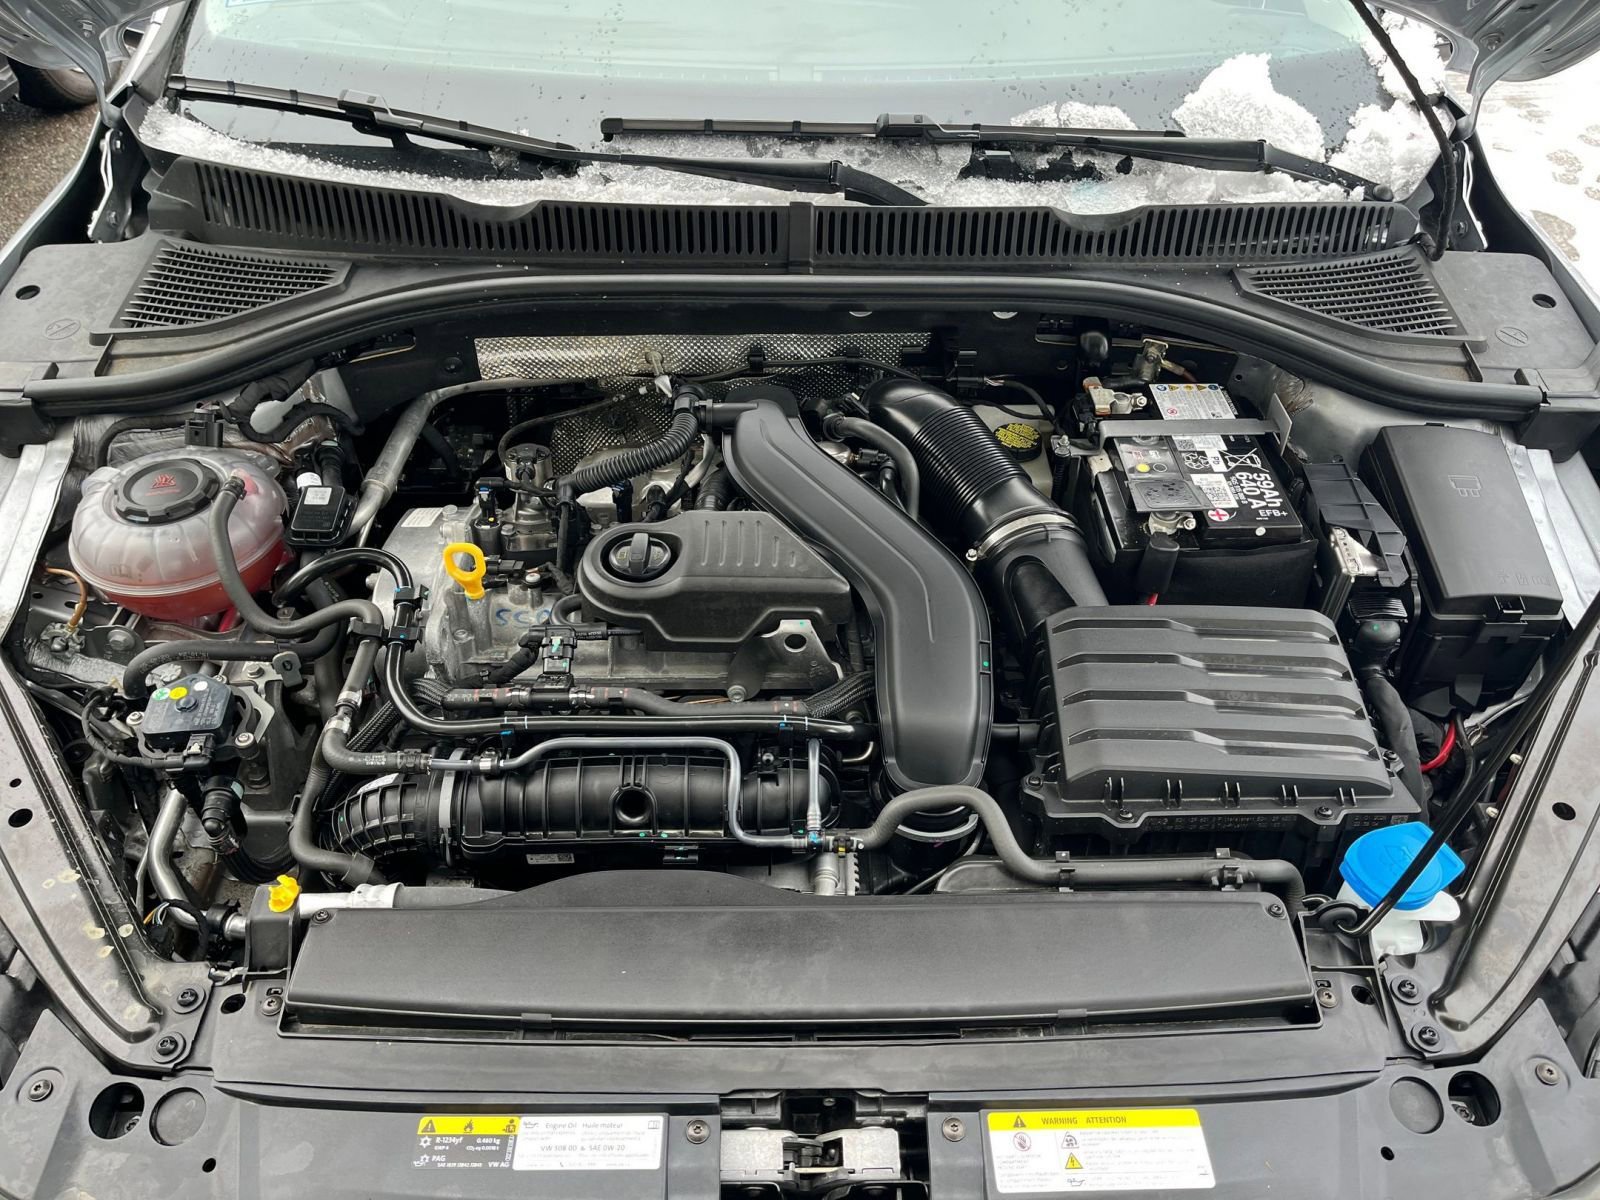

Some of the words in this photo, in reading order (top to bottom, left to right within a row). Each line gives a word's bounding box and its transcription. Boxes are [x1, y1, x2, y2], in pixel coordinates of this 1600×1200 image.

[1211, 456, 1220, 465] Pb
[1235, 472, 1260, 496] 640
[1253, 472, 1283, 507] 59Ah
[1247, 498, 1267, 509] A
[1258, 509, 1288, 517] EFB+
[1041, 1116, 1078, 1125] WARNING
[1085, 1115, 1127, 1124] ATTENTION
[545, 1122, 567, 1131] Engine
[435, 1136, 463, 1145] R-1234yf
[493, 1137, 501, 1145] kg
